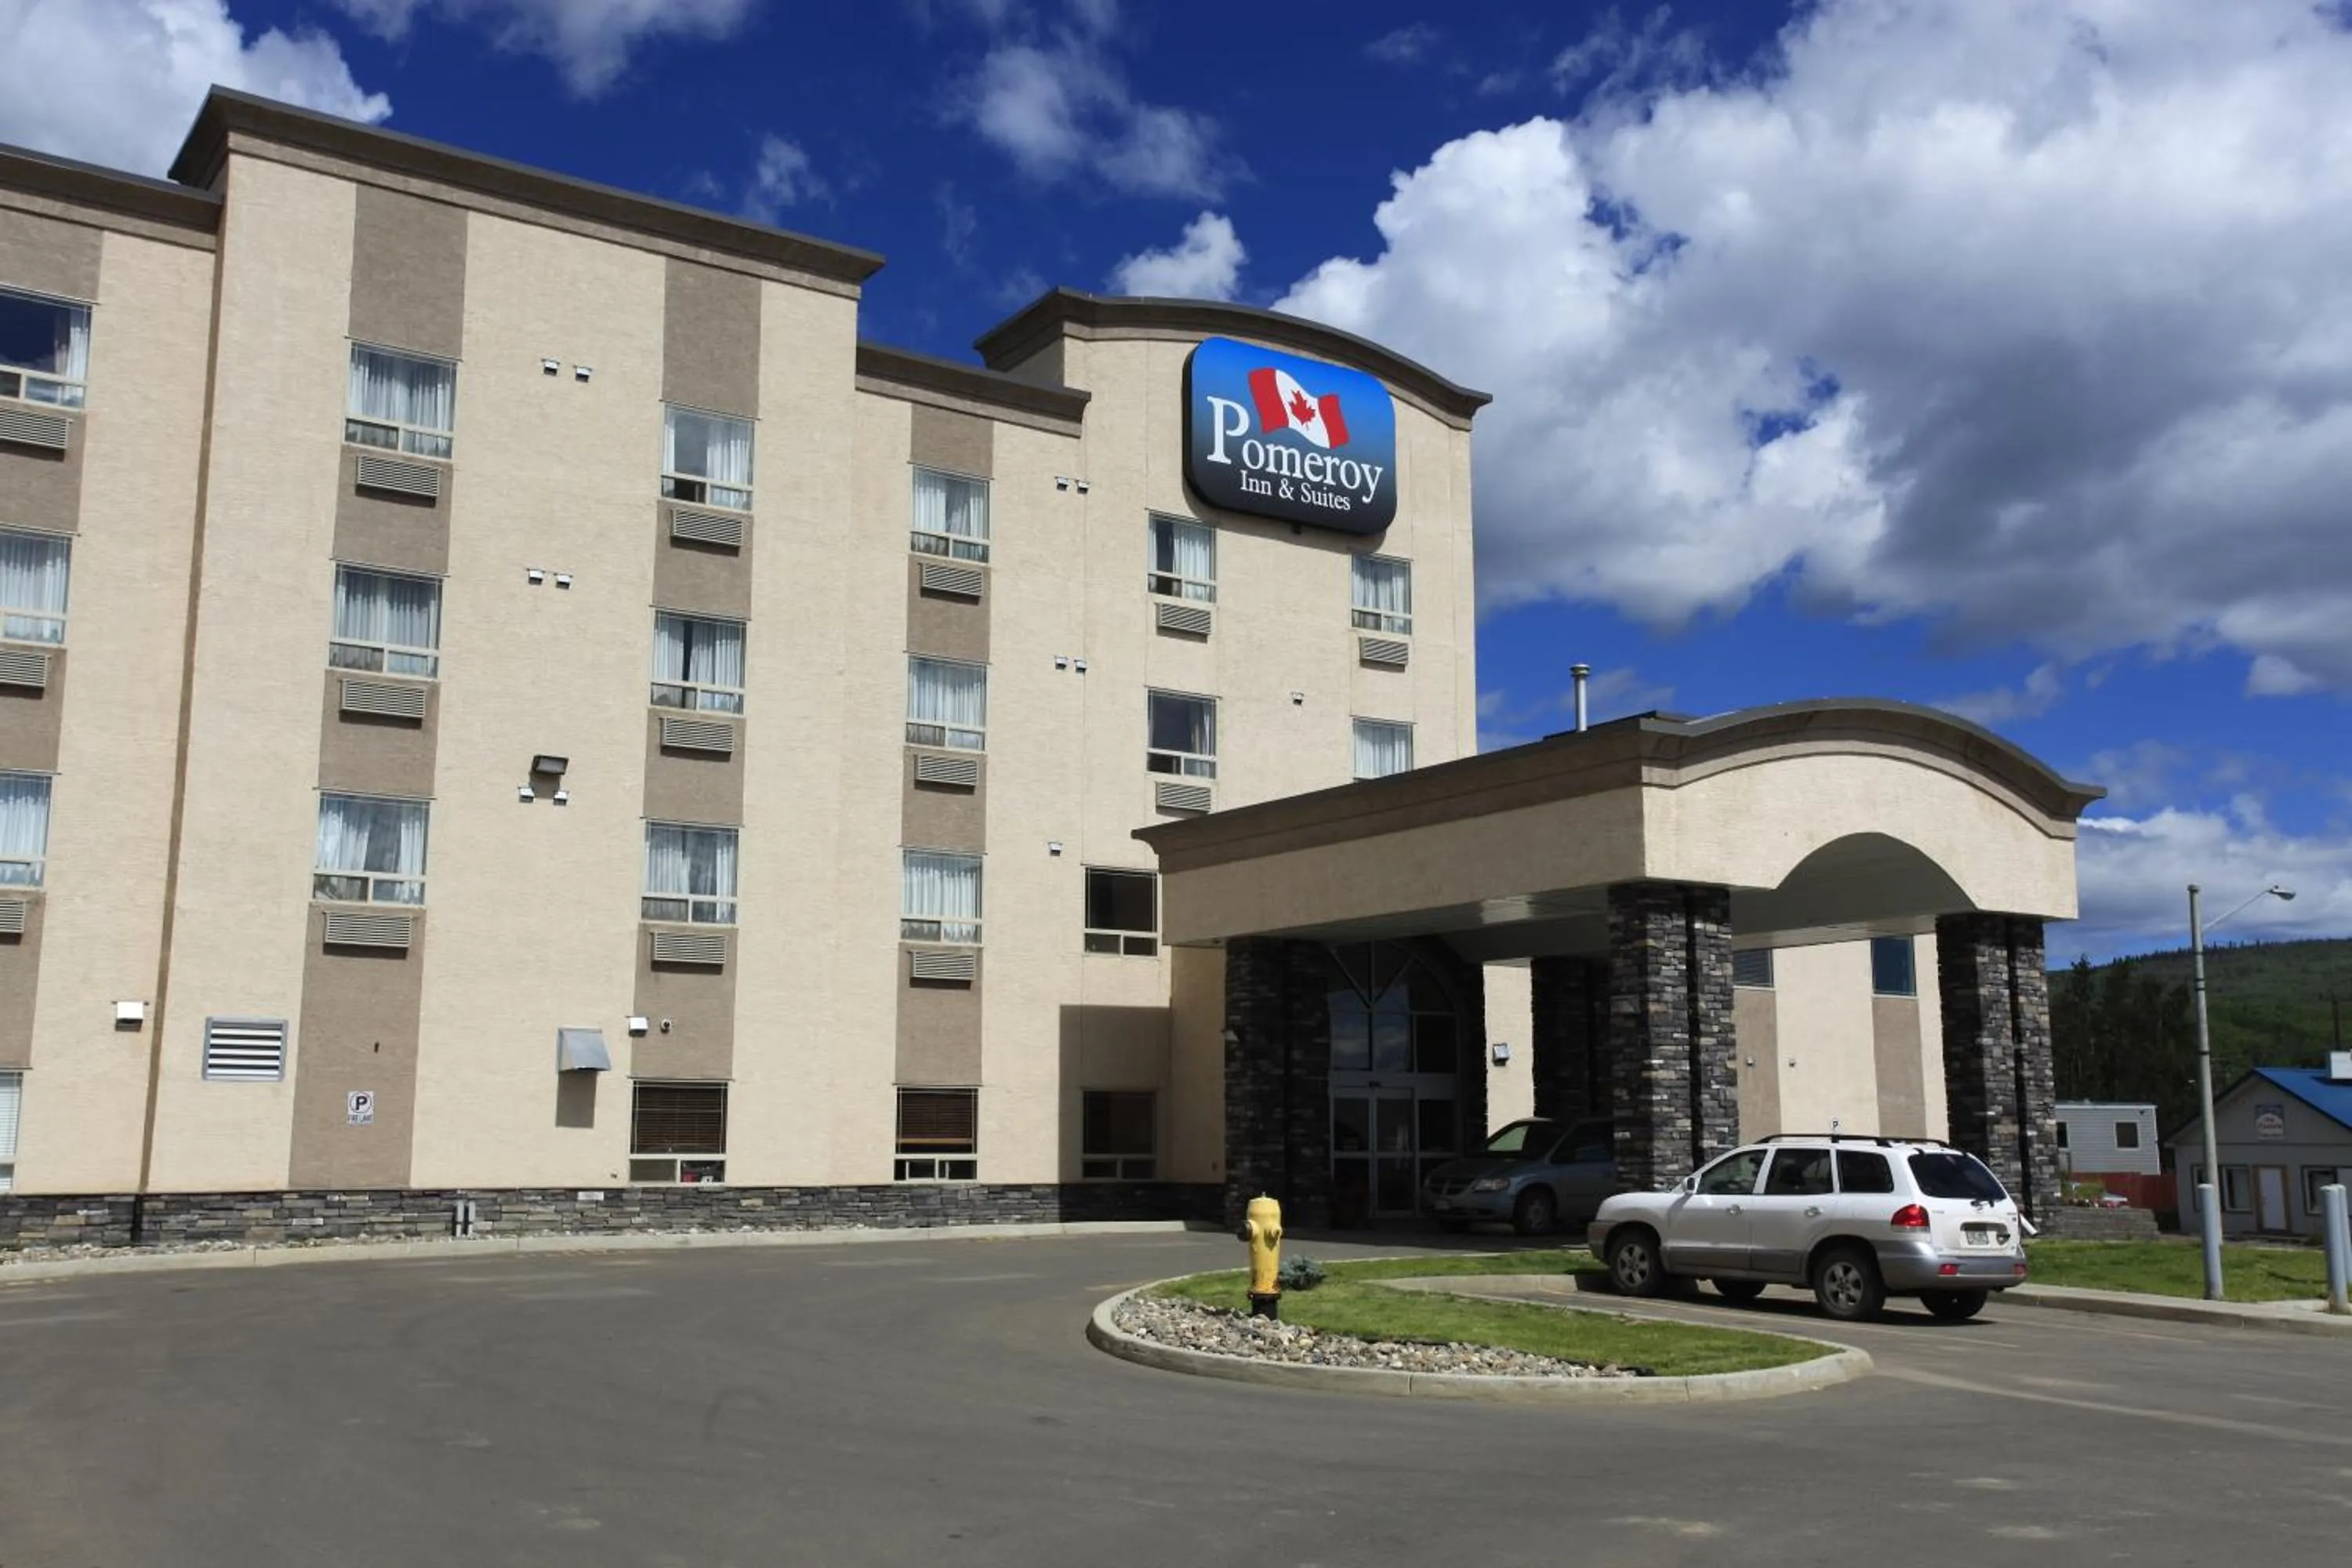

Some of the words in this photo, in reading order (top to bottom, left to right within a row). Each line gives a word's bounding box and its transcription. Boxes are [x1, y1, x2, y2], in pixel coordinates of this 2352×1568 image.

[1206, 395, 1384, 504] Pomeroy
[1240, 470, 1272, 496] Inn
[1278, 477, 1295, 501] &
[1300, 481, 1352, 511] Suites
[356, 1096, 368, 1110] P
